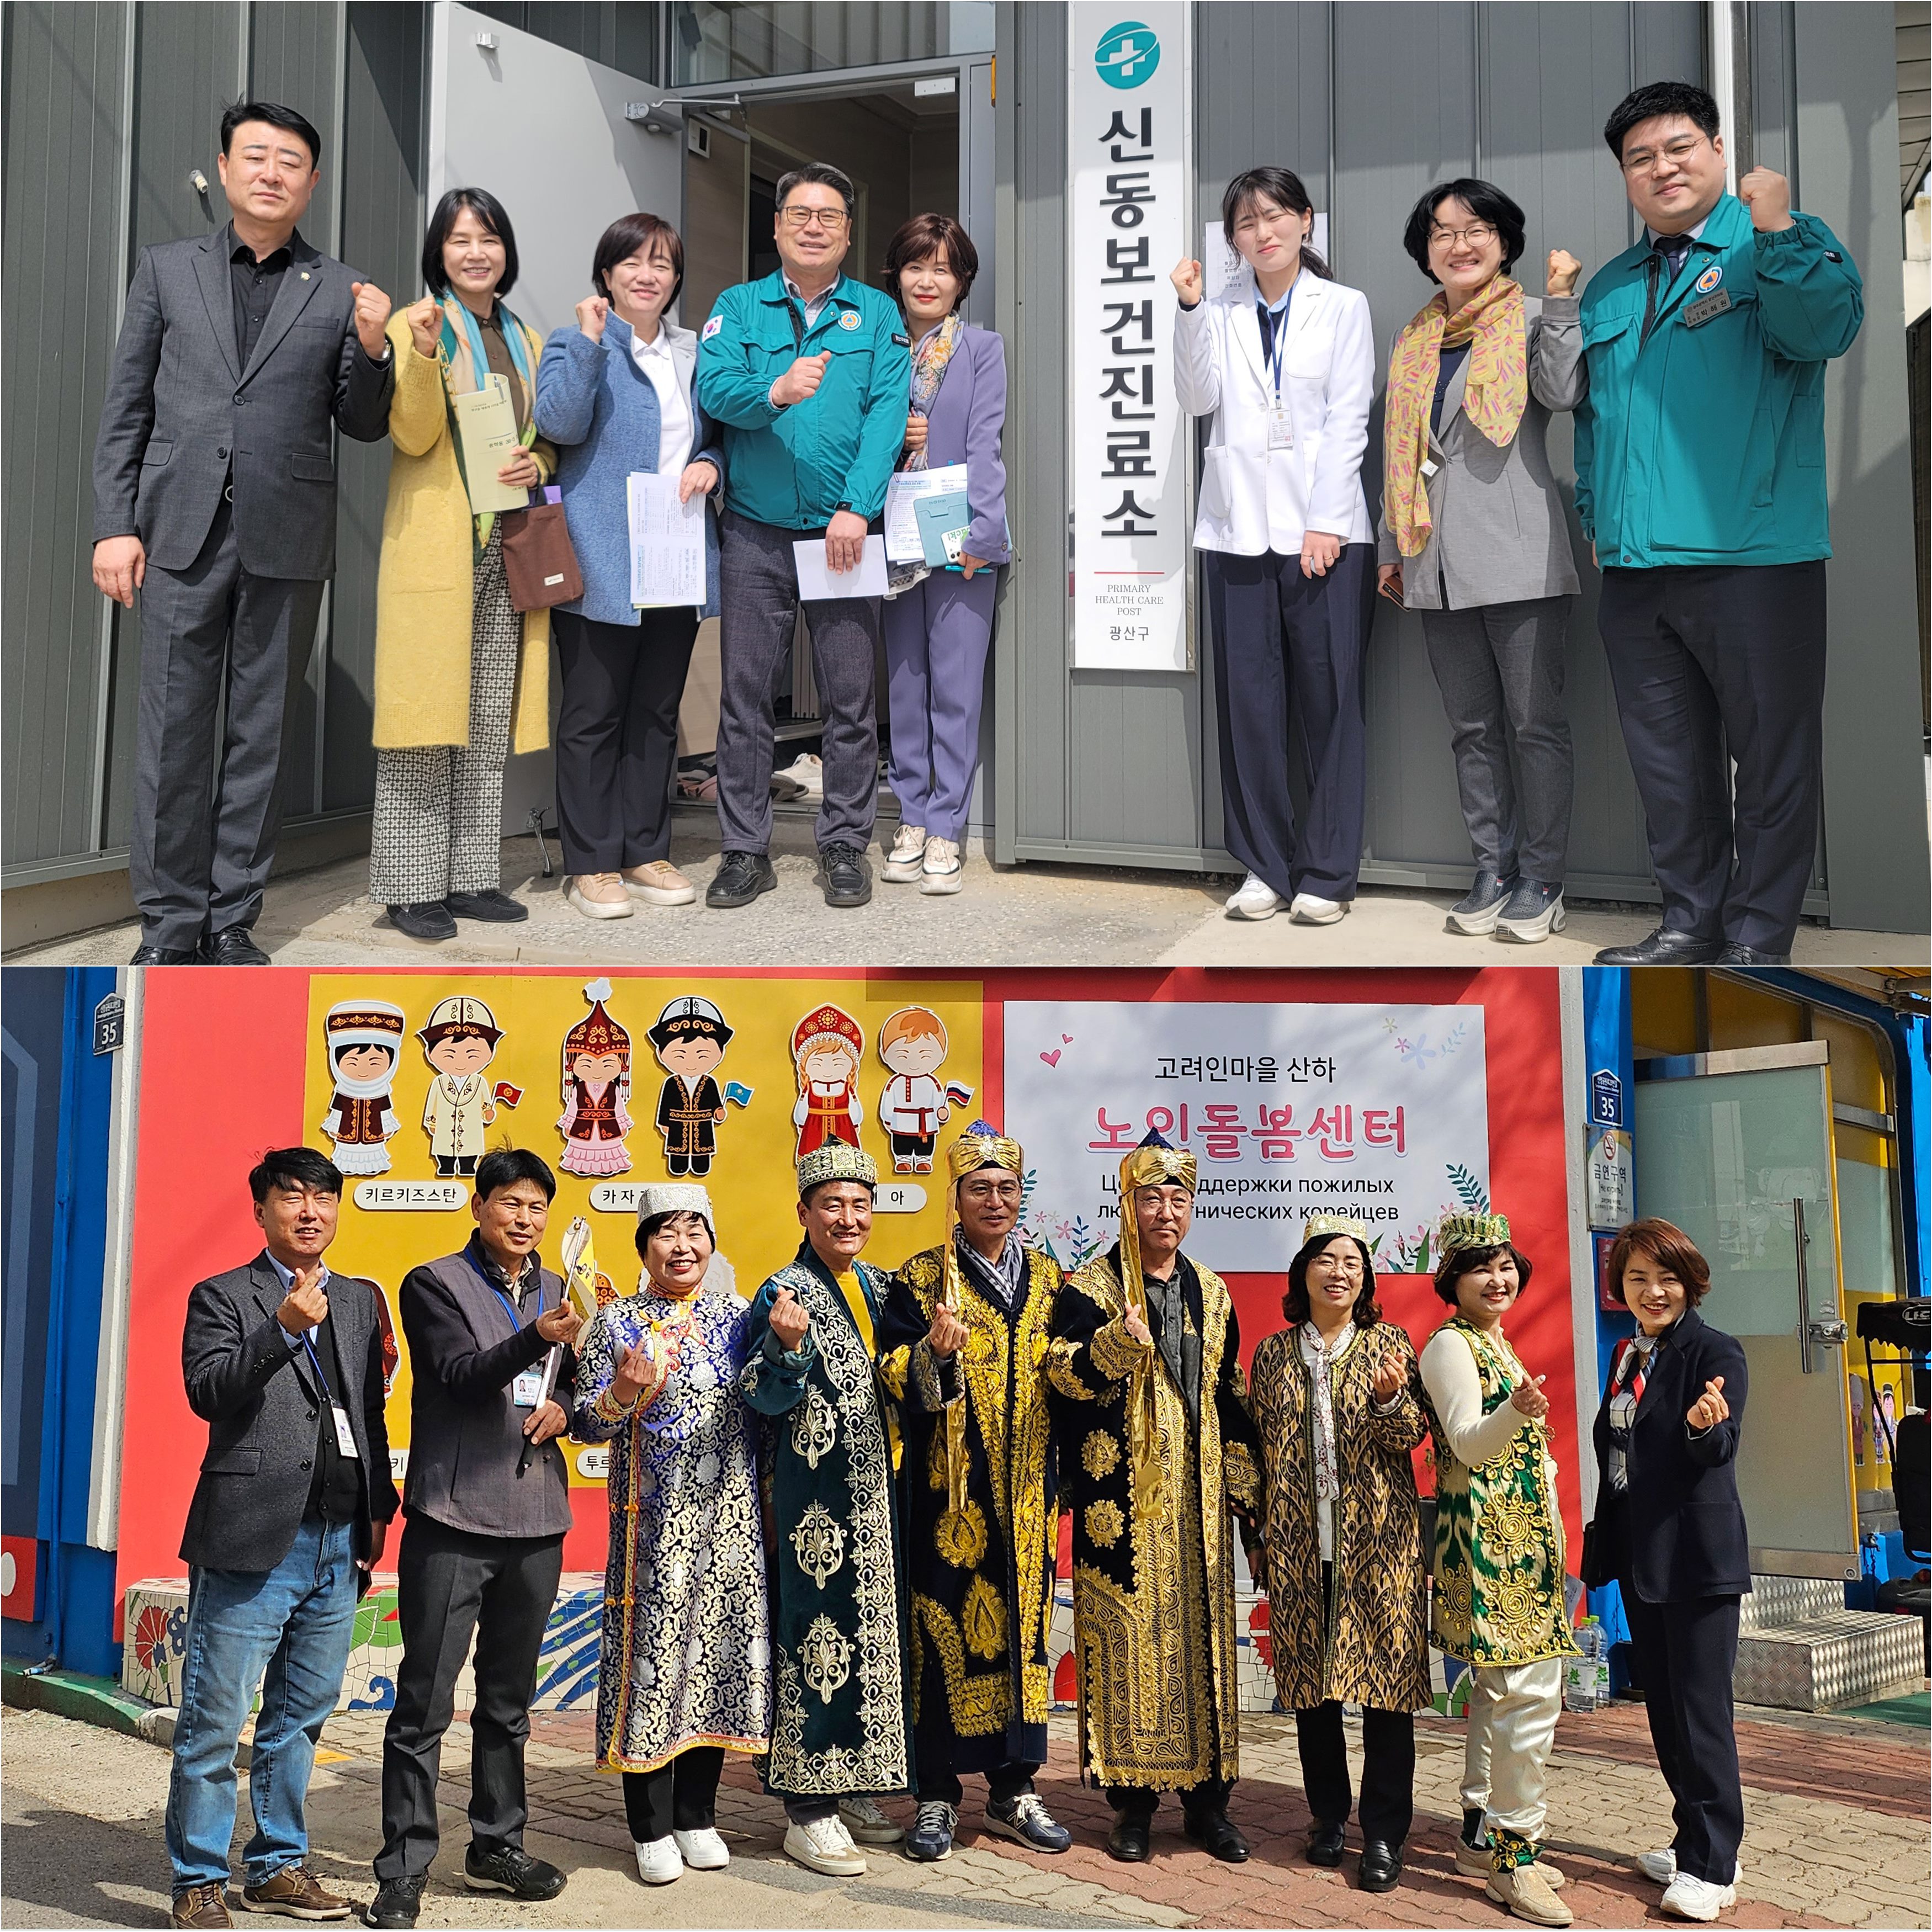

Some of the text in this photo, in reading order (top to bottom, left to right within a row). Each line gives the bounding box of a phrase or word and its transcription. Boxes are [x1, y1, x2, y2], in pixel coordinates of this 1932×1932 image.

[1098, 107, 1157, 536] 신동보건진료소
[1107, 585, 1151, 593] PRIMARY
[1095, 596, 1164, 605] HEALTH CARE
[1117, 607, 1142, 615] POST
[1110, 626, 1149, 641] 광산구
[101, 1022, 117, 1045] 35
[1155, 1056, 1336, 1083] 고려인마을 산하
[1601, 1096, 1615, 1118] 35
[1089, 1102, 1404, 1159] 노인돌봄센터
[1594, 1163, 1627, 1183] 금연구역
[365, 1188, 457, 1203] 키르키즈스탄
[1197, 1179, 1292, 1196] ддержки
[1299, 1179, 1394, 1193] пожилых
[1192, 1205, 1292, 1219] нических
[1299, 1202, 1399, 1223] корейцев
[586, 1456, 609, 1470] 투르
